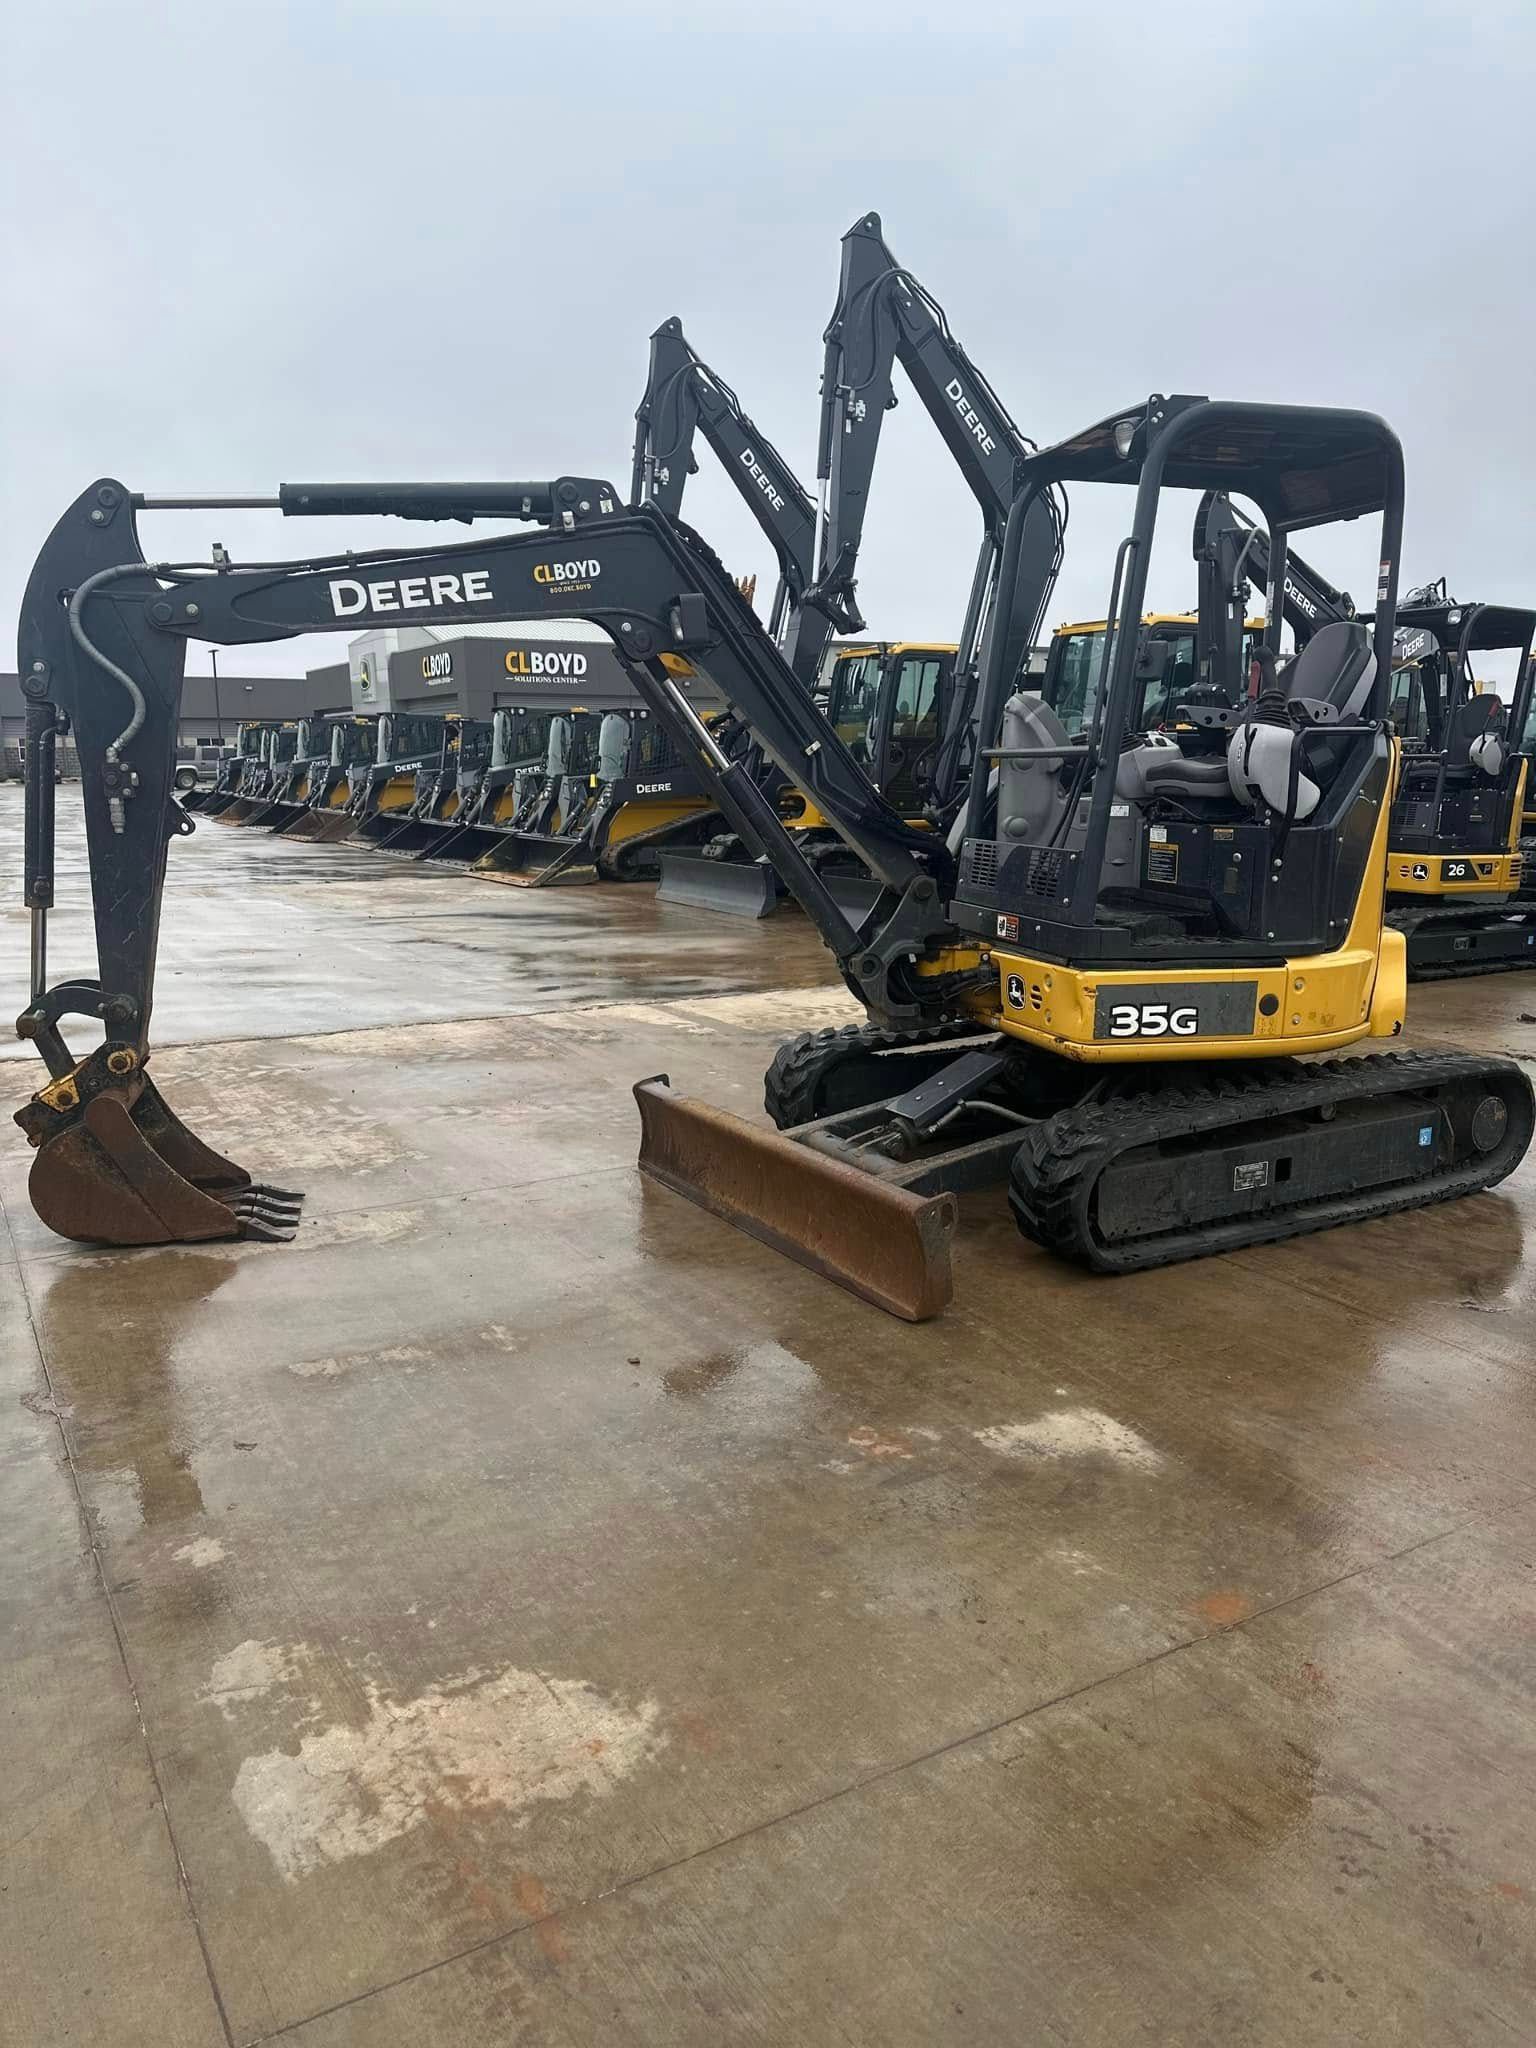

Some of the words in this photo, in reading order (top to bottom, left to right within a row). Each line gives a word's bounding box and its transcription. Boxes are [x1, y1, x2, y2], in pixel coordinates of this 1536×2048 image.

[945, 378, 997, 456] DEERE
[739, 448, 785, 512] DEERE
[533, 560, 601, 583] CLBOYD
[328, 570, 494, 617] DEERE
[1283, 576, 1318, 619] DEERE
[1402, 633, 1426, 661] DEERE
[422, 652, 451, 678] CLBOYD
[505, 651, 587, 675] CLBOYD
[514, 675, 552, 683] SOLUTIONS
[552, 676, 579, 684] CENTER
[394, 762, 423, 773] DEERE
[514, 765, 541, 774] DEER
[636, 783, 672, 794] DEERE
[1448, 864, 1465, 876] 26
[1110, 1005, 1198, 1036] 35G
